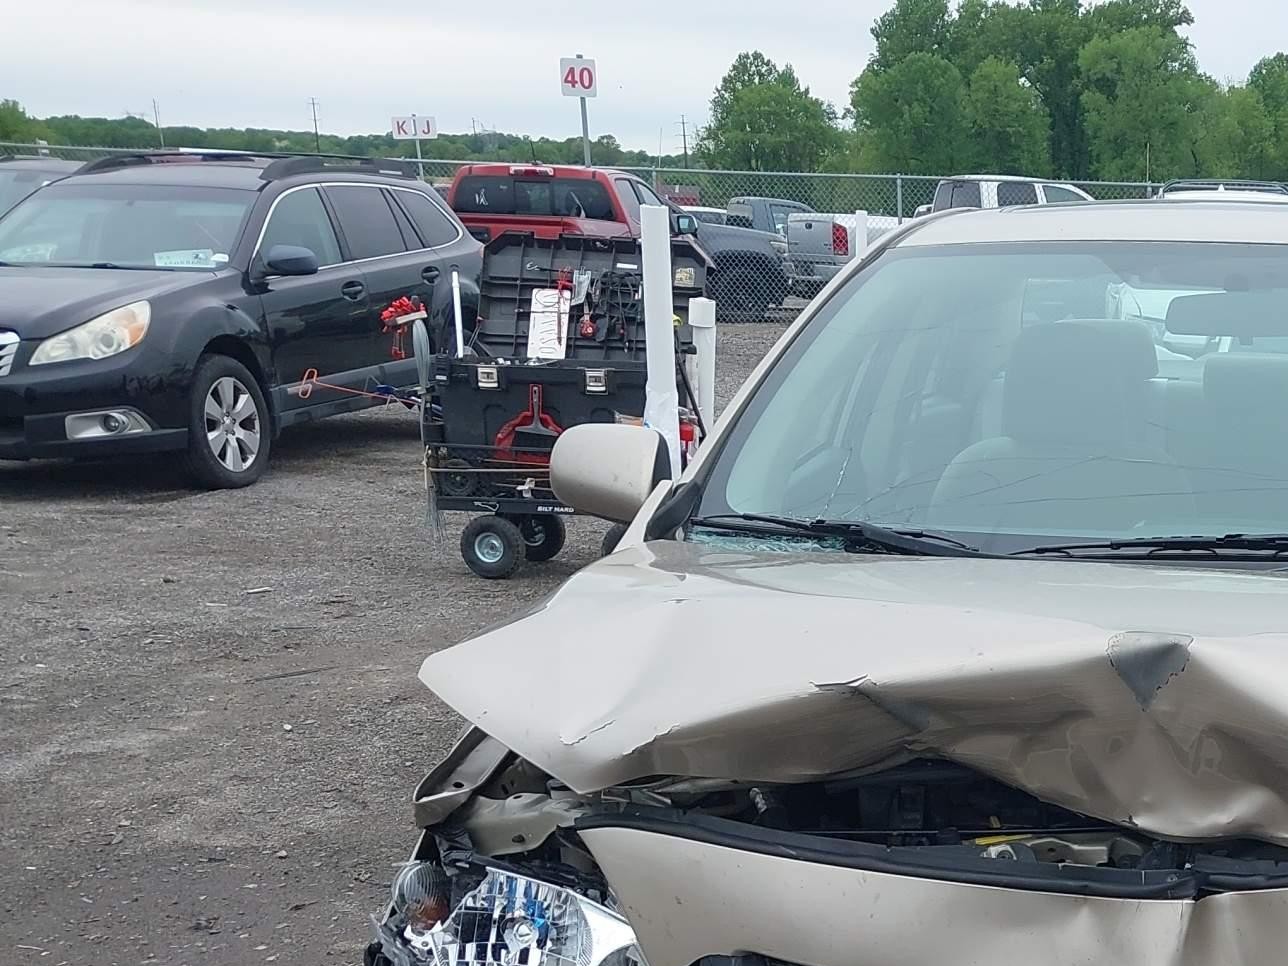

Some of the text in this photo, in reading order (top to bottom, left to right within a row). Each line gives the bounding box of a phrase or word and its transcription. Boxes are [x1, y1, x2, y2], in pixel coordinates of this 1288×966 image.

[563, 66, 594, 90] 40
[396, 119, 431, 136] K J
